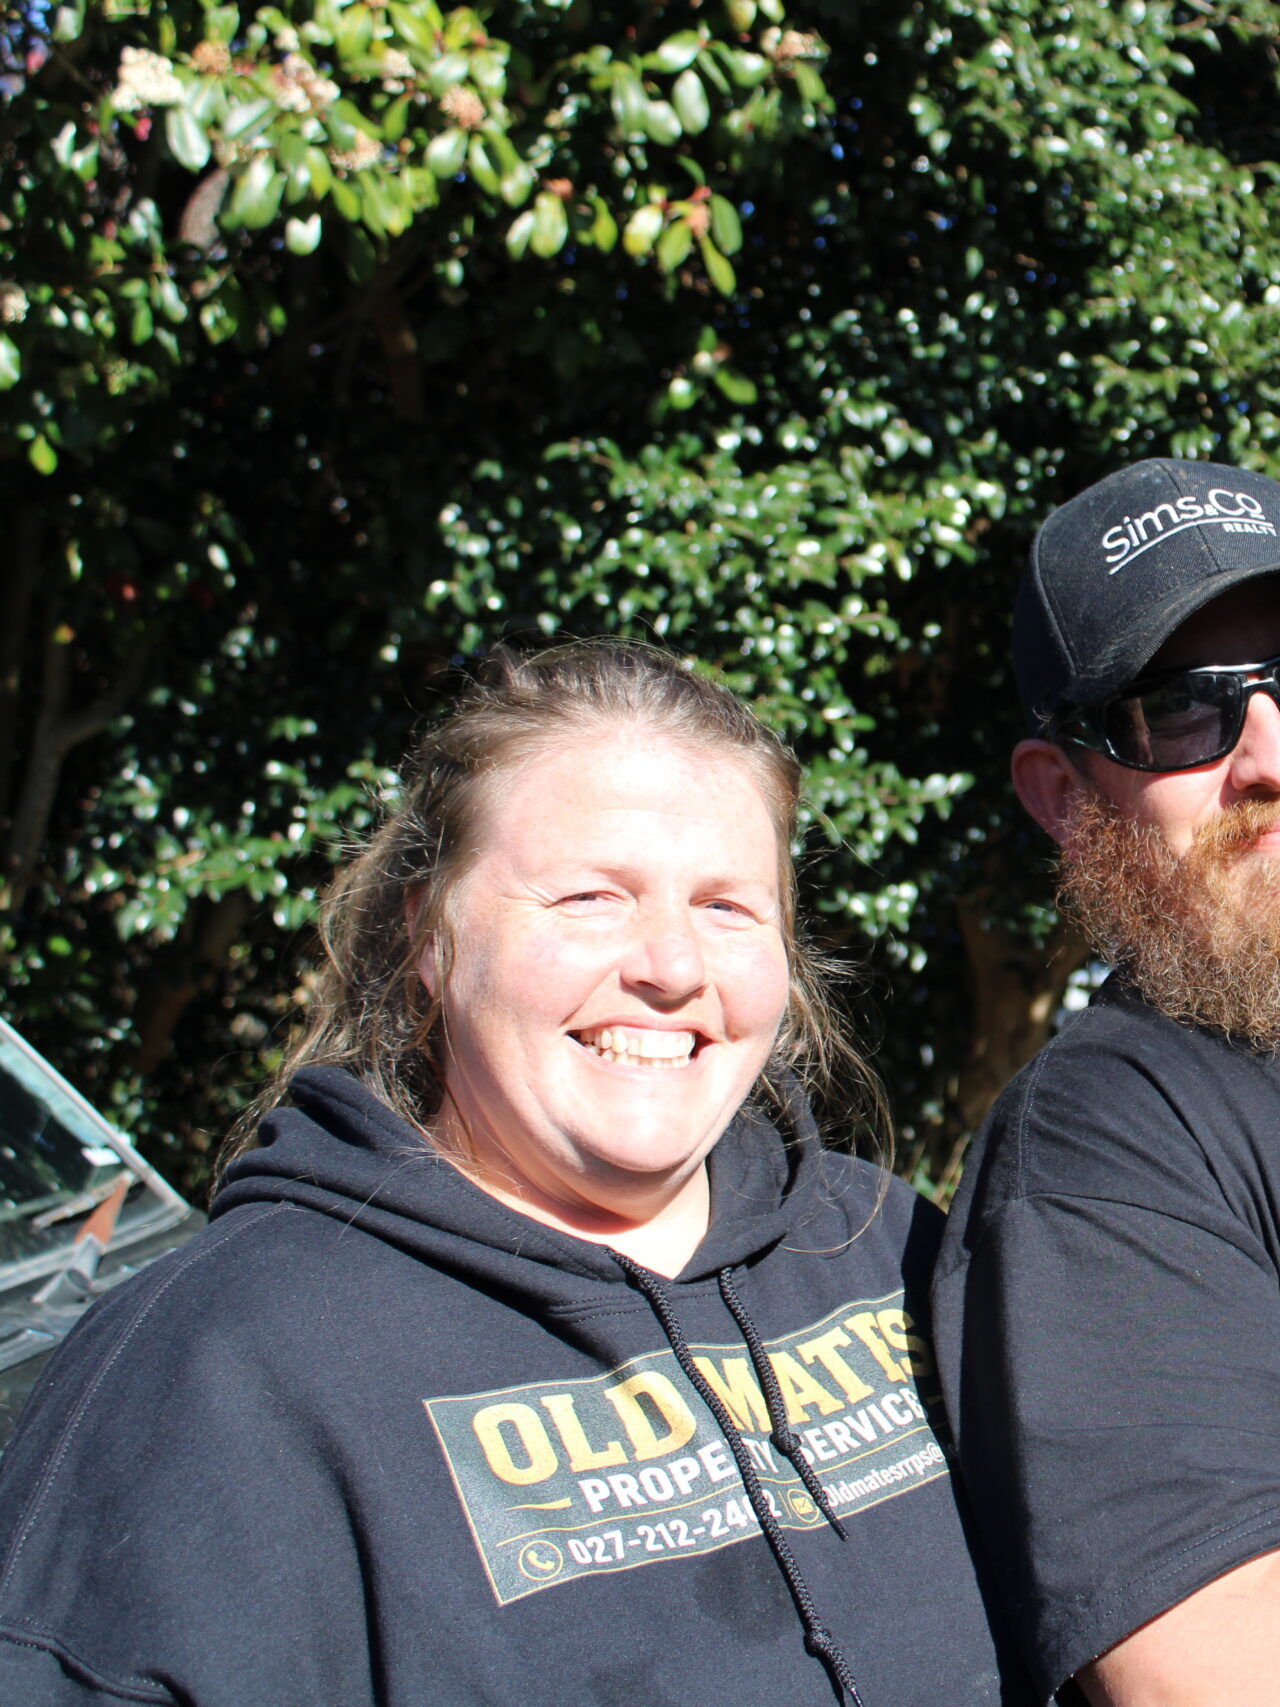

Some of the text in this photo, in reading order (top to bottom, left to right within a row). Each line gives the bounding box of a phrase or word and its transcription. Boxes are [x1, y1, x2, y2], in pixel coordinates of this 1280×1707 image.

[1222, 522, 1278, 537] REALTY
[472, 1371, 697, 1485] OLD
[578, 1437, 779, 1513] PROPETY
